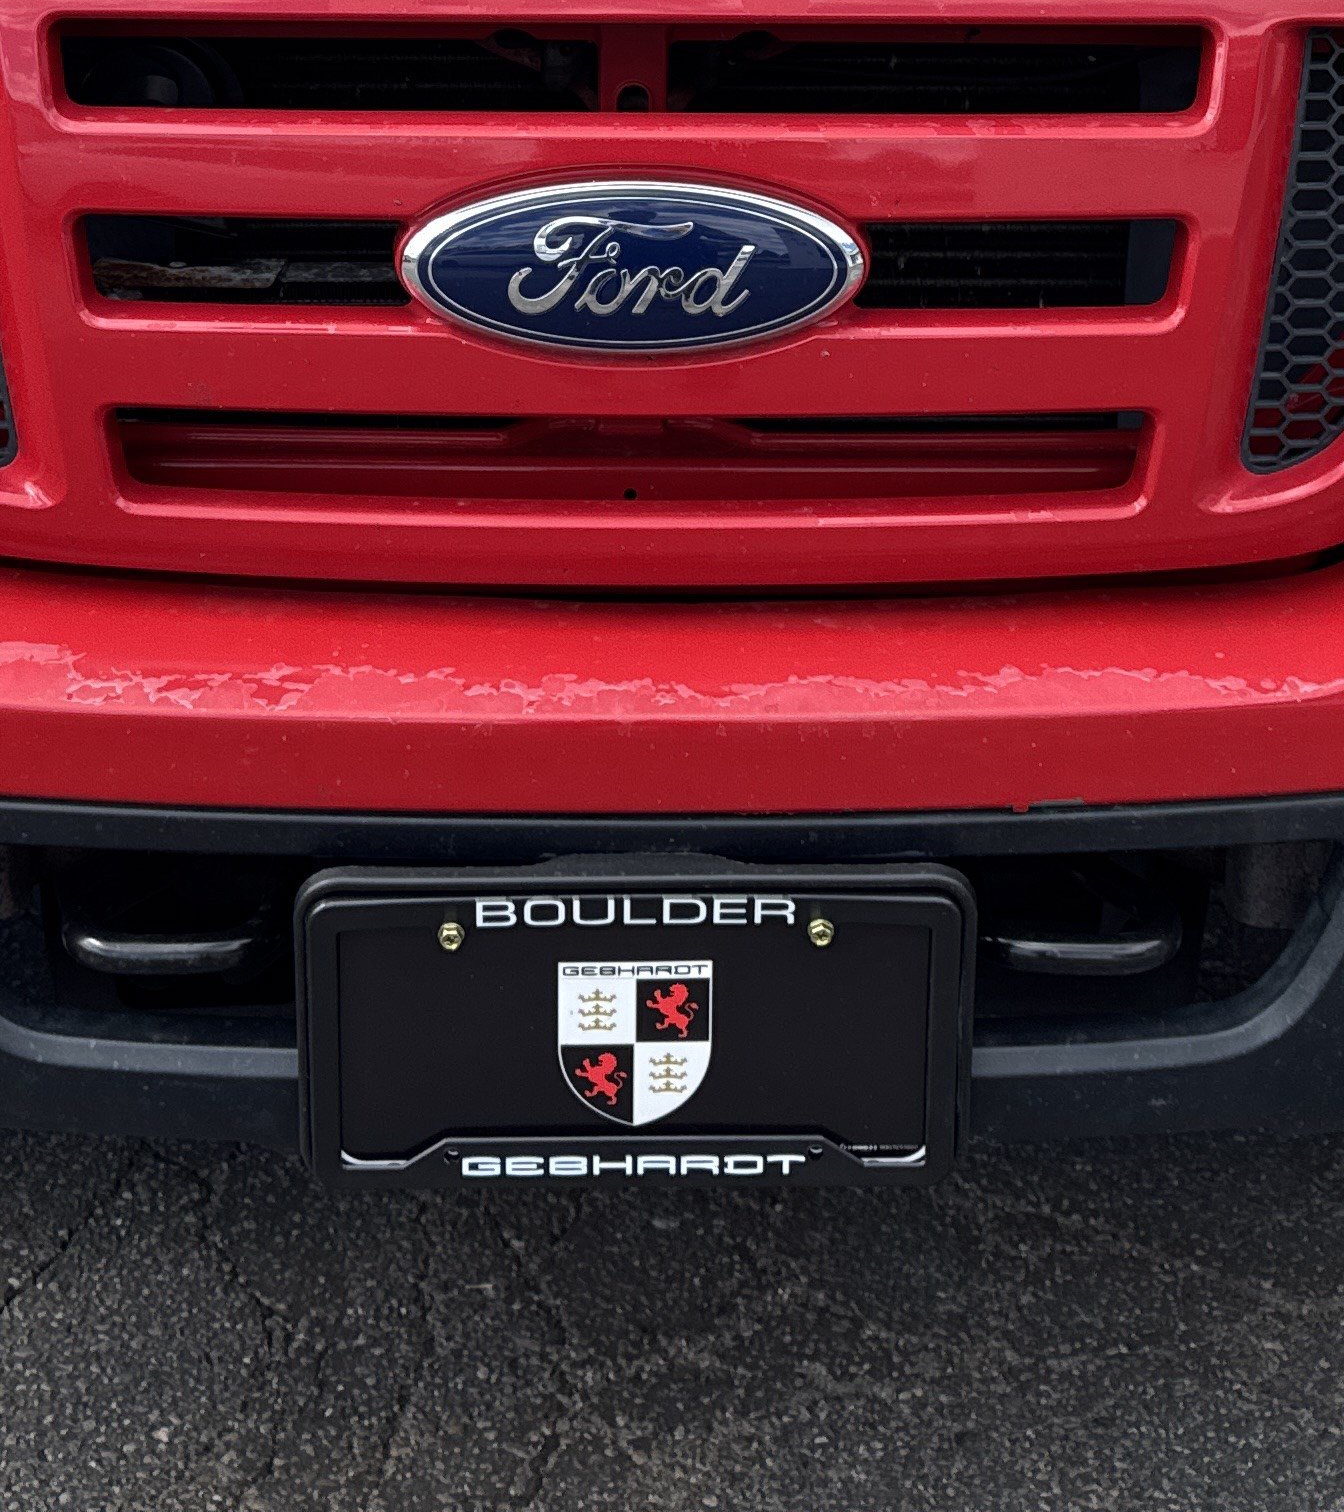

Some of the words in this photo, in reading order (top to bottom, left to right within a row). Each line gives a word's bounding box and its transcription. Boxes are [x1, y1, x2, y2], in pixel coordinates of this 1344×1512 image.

[506, 215, 756, 317] Ford
[474, 893, 796, 928] BOULDER
[561, 963, 710, 977] GEBHARDT
[461, 1154, 805, 1177] GEBHARDT
